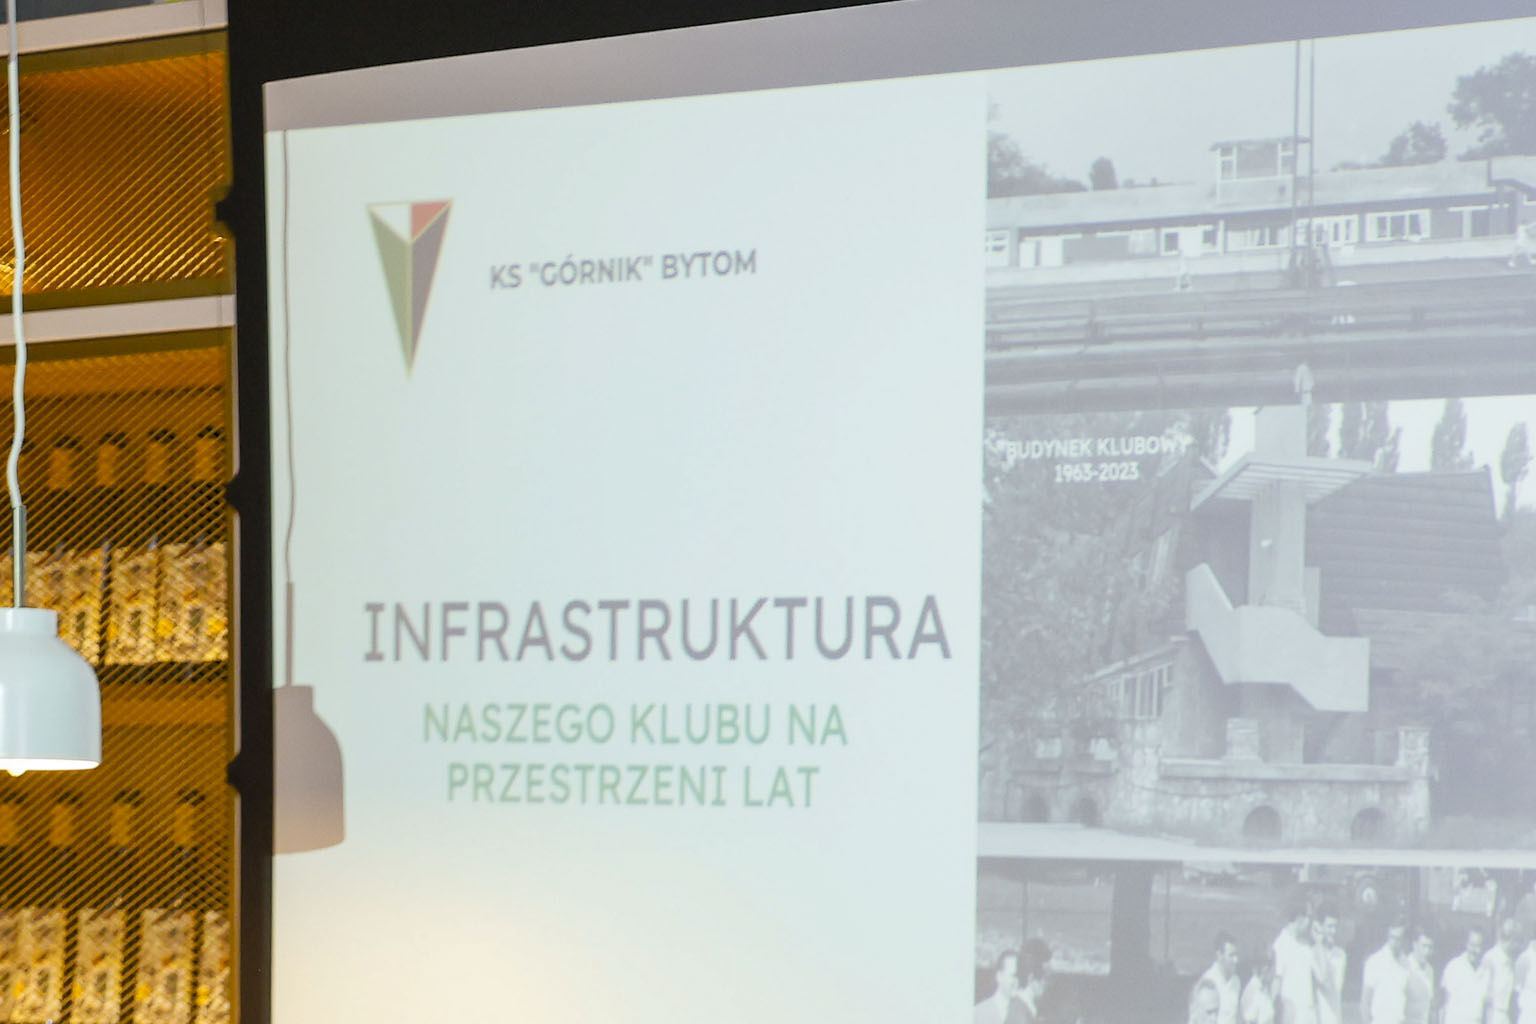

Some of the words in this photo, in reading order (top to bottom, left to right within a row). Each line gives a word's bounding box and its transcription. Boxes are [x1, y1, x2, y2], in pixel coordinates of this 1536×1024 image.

[489, 264, 522, 289] KS
[530, 254, 653, 287] "GÓRNIK"
[661, 249, 757, 280] BYTOM
[1006, 438, 1091, 460] BUDYNEK
[1097, 435, 1193, 456] KLUBOWY
[1055, 461, 1139, 483] 1963-2023
[363, 594, 952, 664] INFRASTRUKTURA
[423, 703, 615, 744] NASZEGO
[630, 704, 772, 746] KLUBU
[787, 704, 848, 747] NA
[447, 763, 726, 807] PRZESTRZENI
[743, 766, 820, 809] LAT
